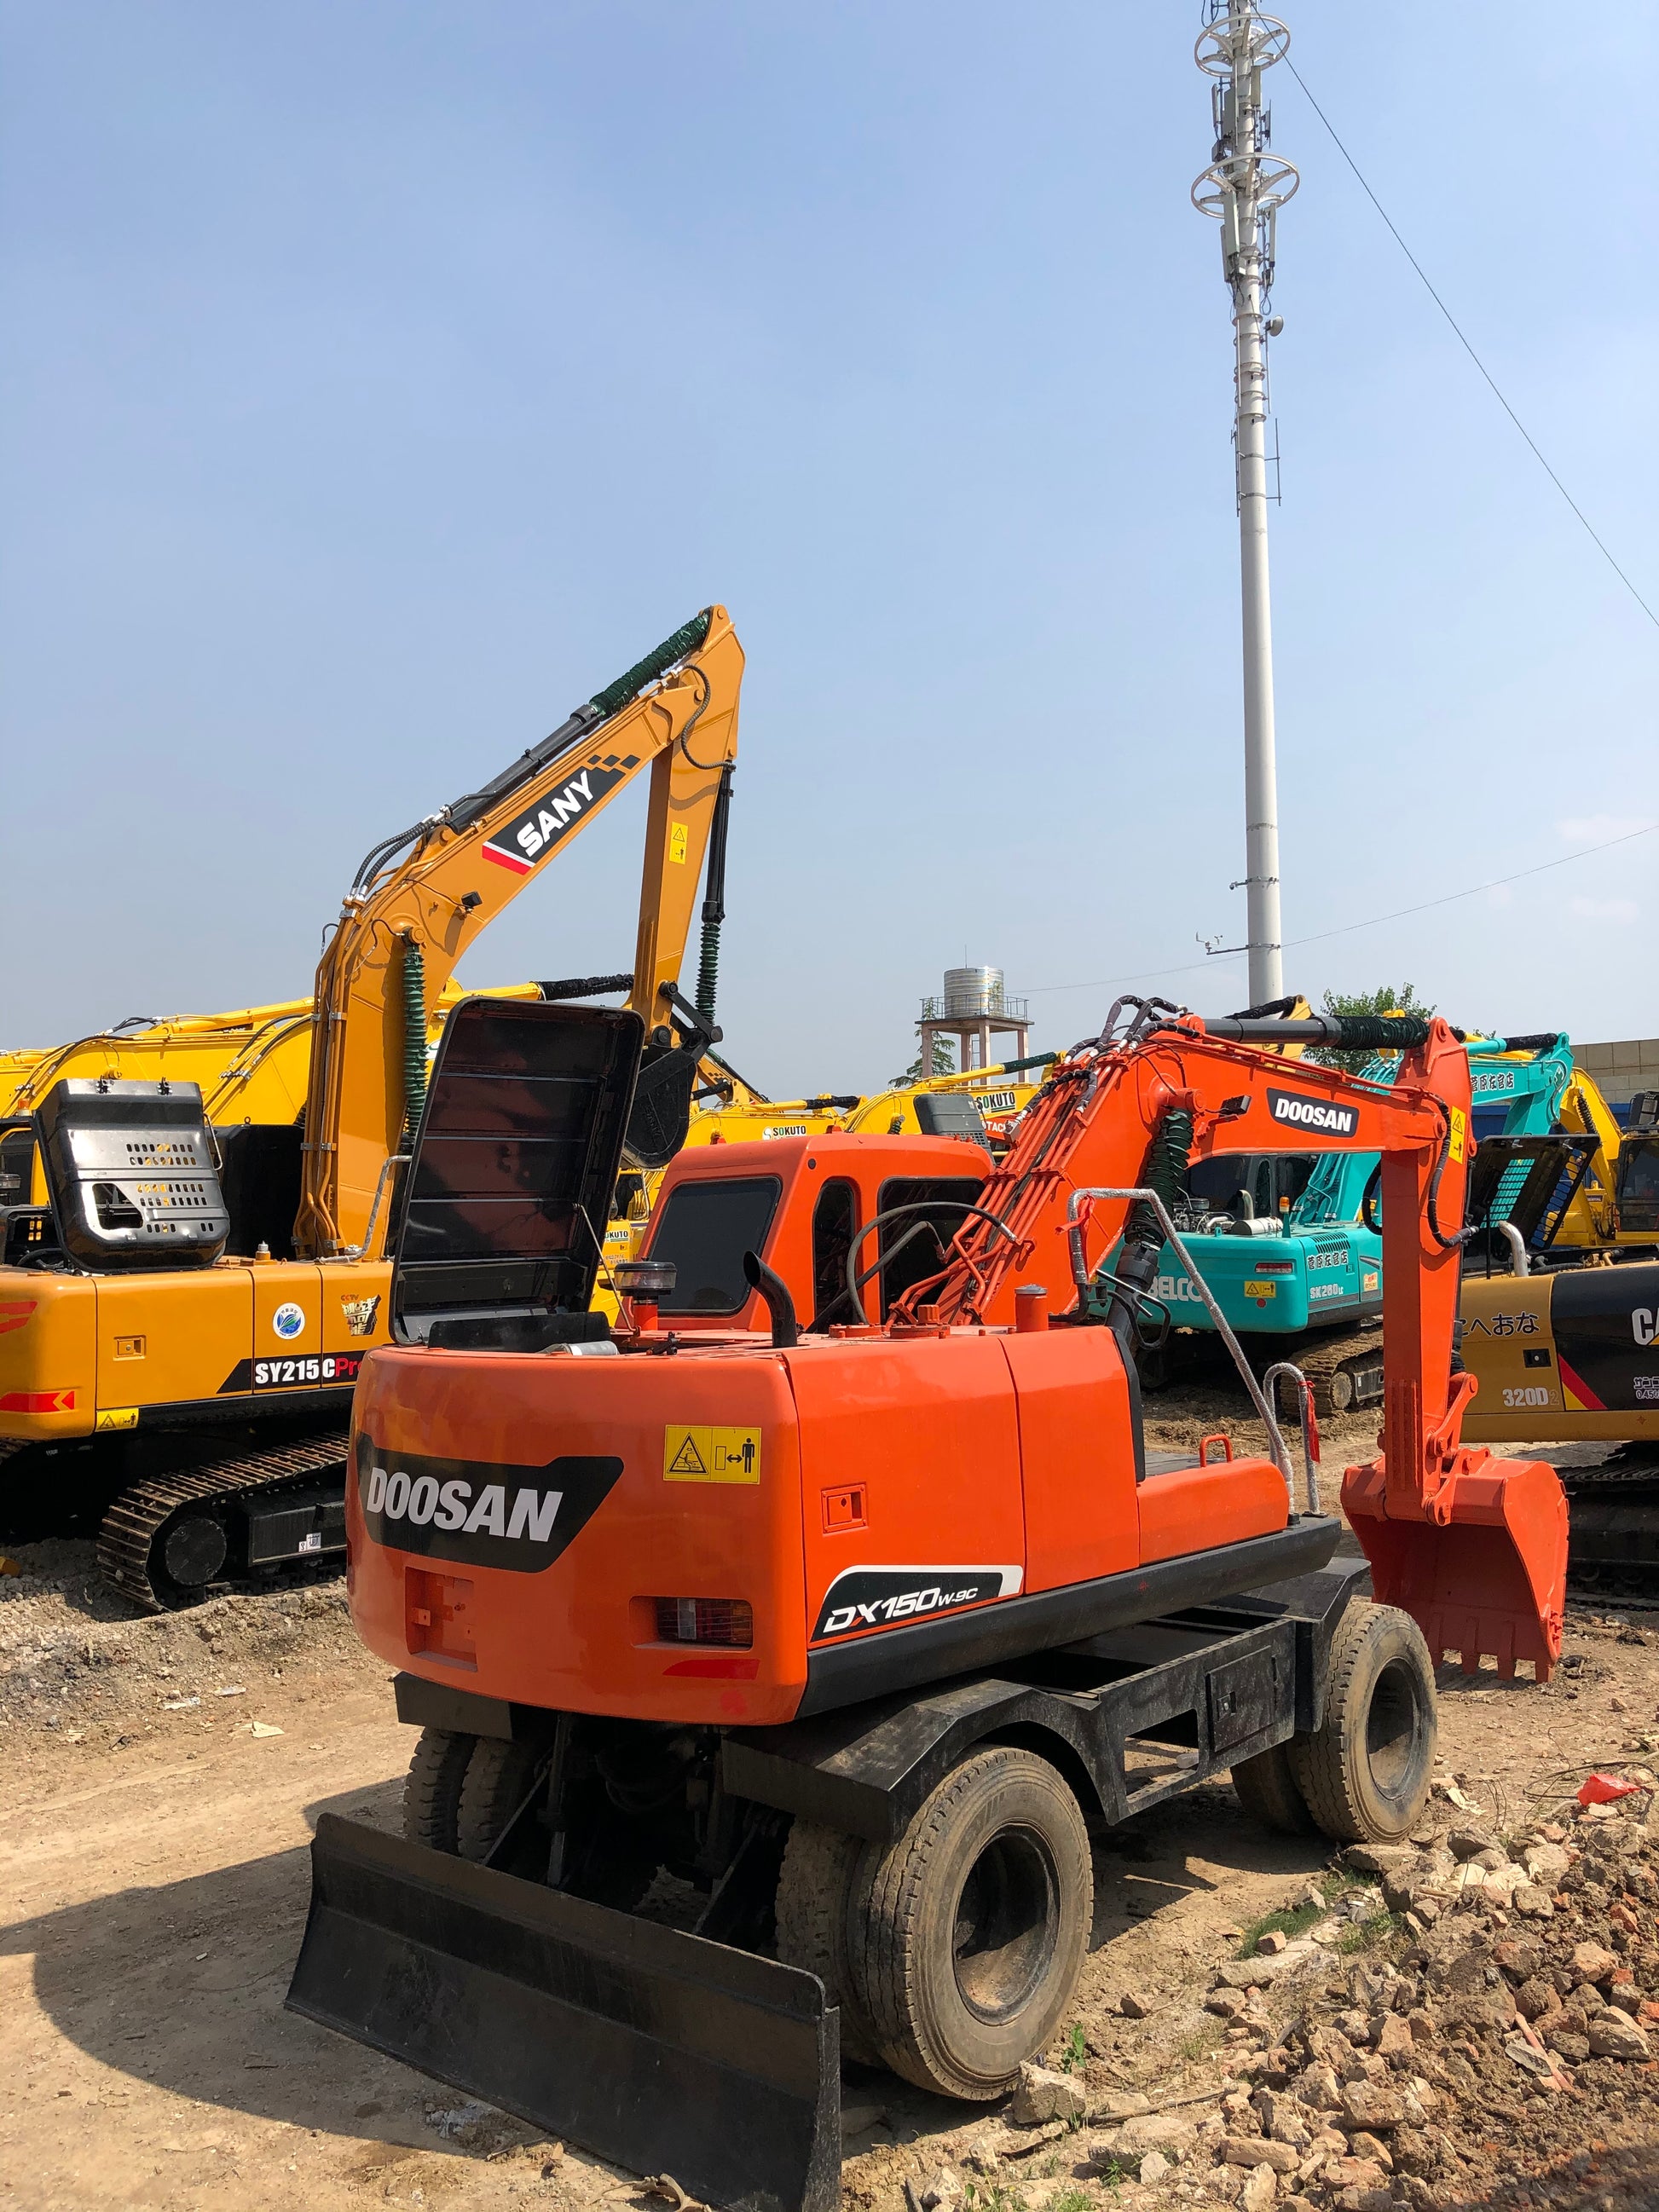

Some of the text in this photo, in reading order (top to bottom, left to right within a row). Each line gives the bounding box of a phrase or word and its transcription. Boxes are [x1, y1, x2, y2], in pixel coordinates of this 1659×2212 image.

[517, 771, 593, 858] SANY
[976, 1092, 1015, 1109] SOKUTO
[1275, 1098, 1352, 1132] DOOSAN
[772, 1125, 806, 1136] SOKUTO
[367, 1467, 564, 1542] DOOSAN
